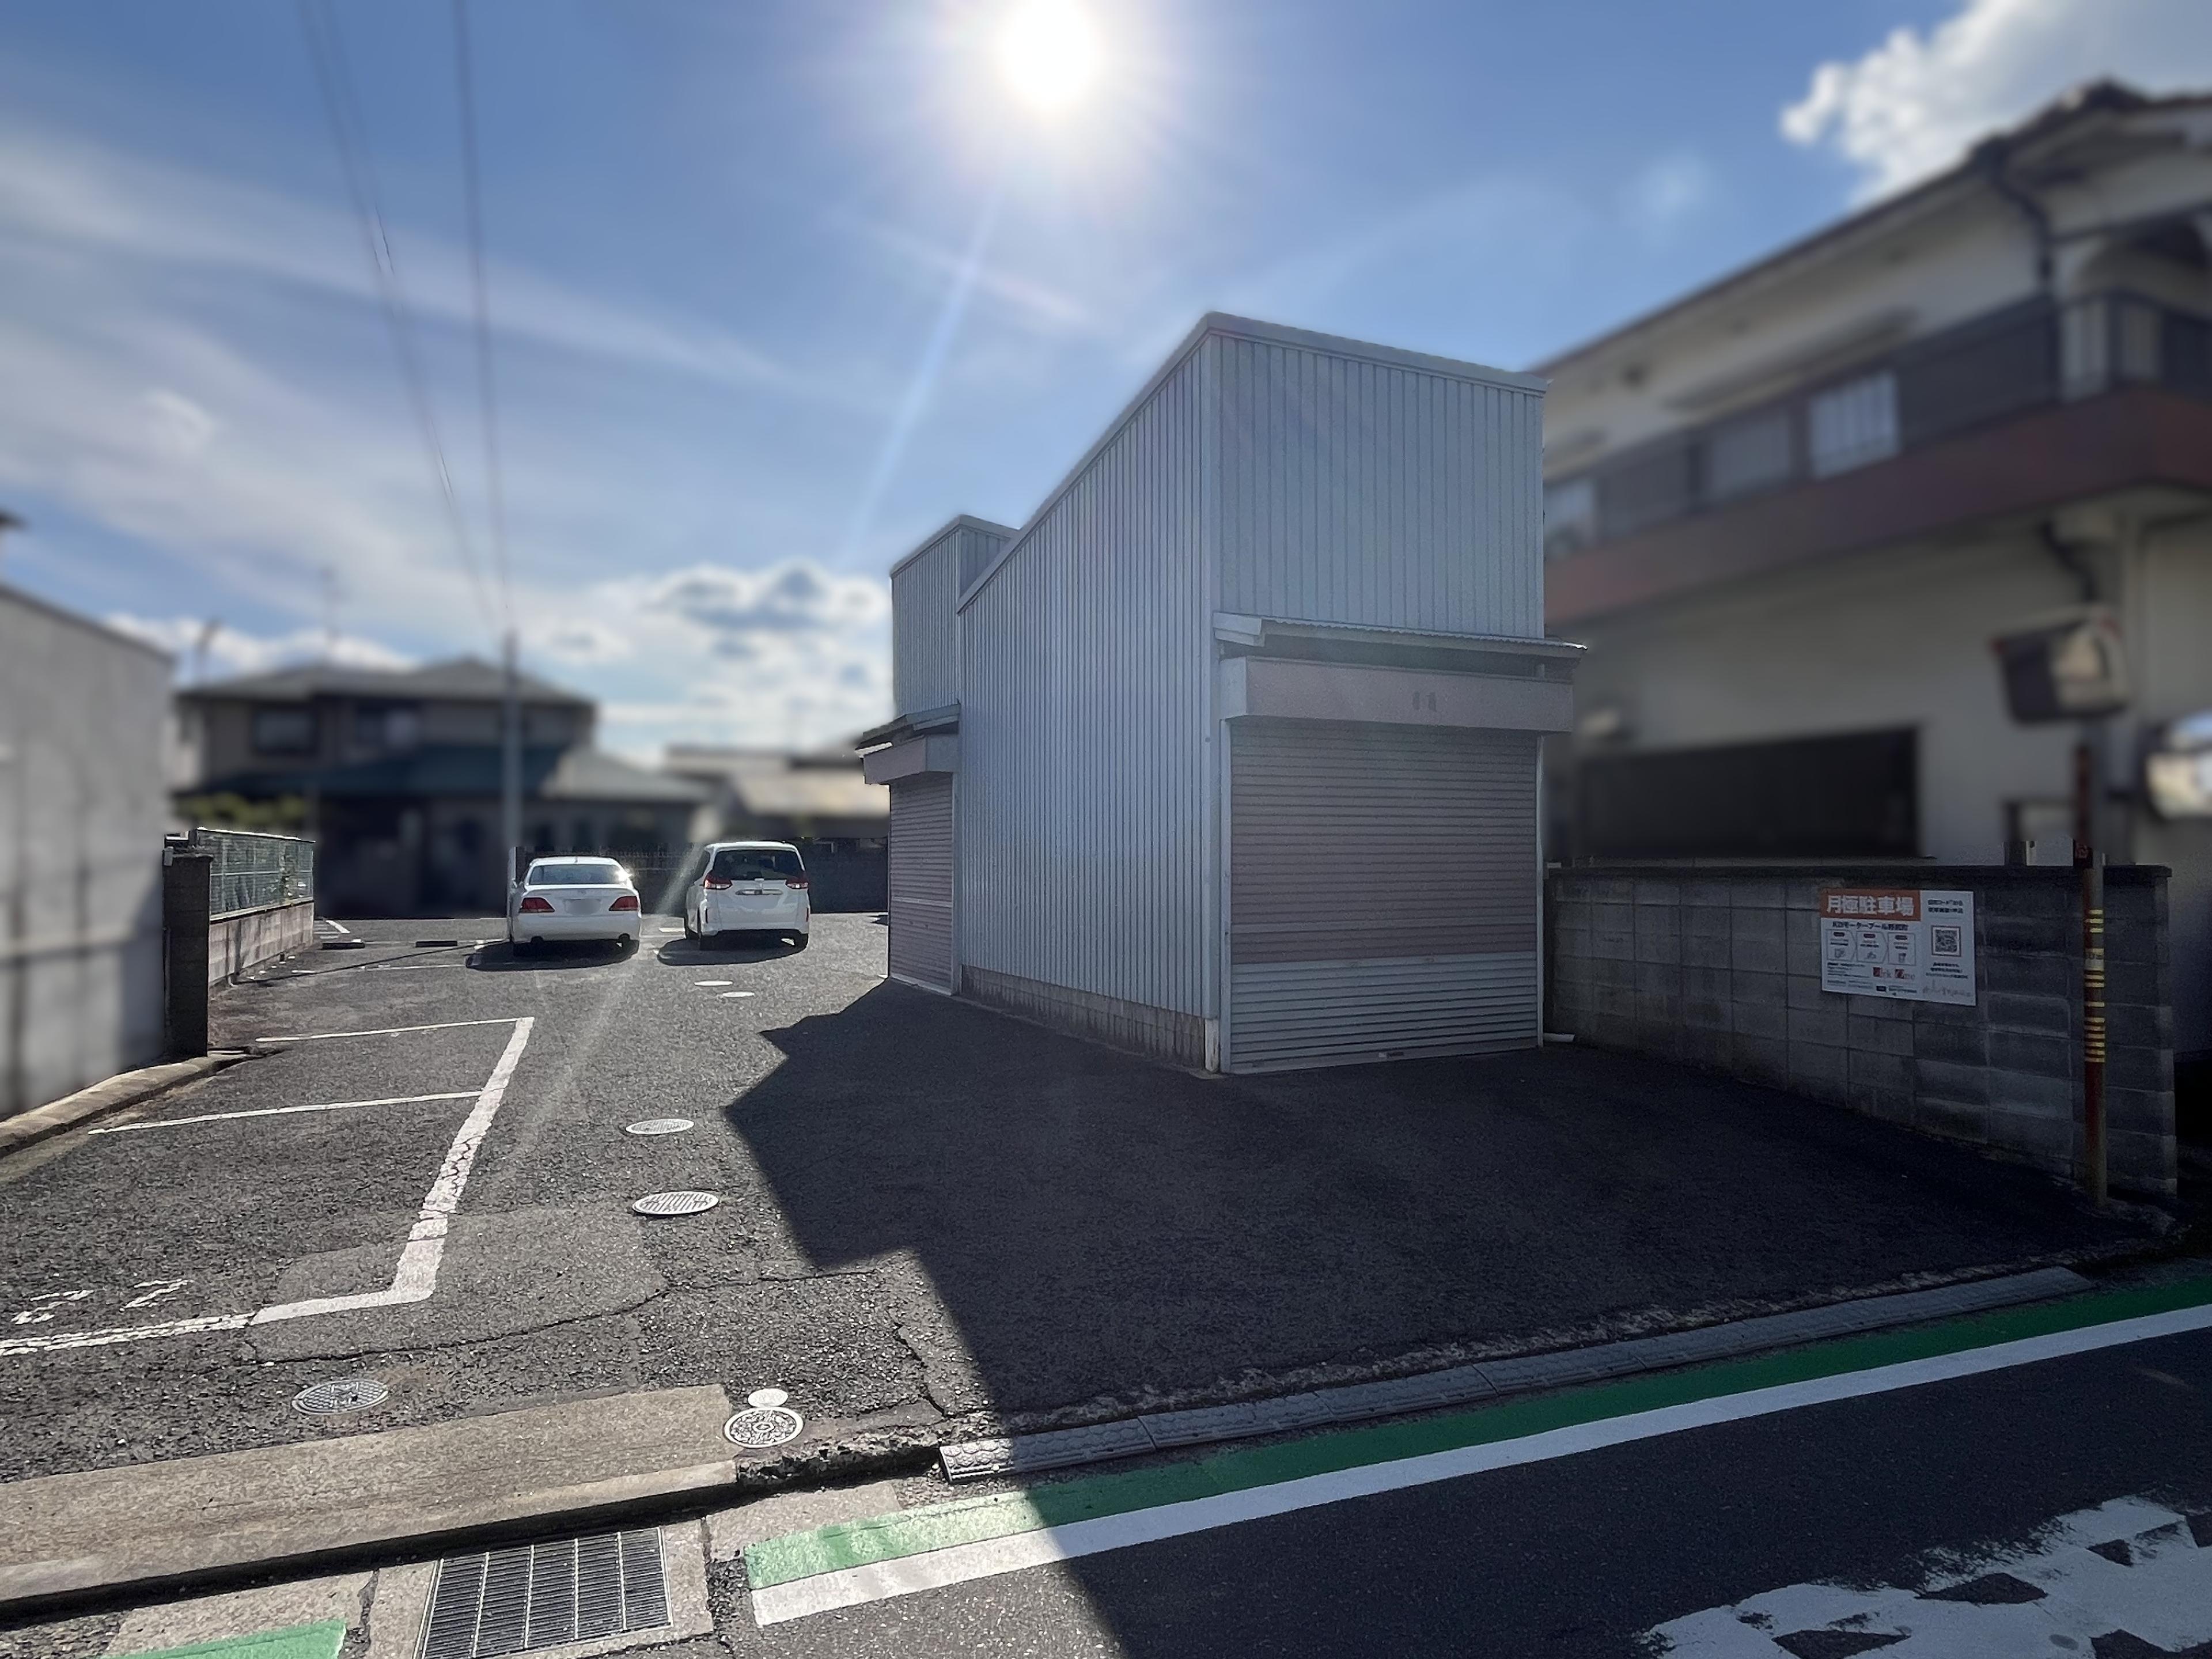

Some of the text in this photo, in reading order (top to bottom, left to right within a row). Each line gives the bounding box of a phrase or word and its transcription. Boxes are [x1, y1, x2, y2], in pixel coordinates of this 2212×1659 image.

[1827, 895, 1915, 916] 月極駐車場
